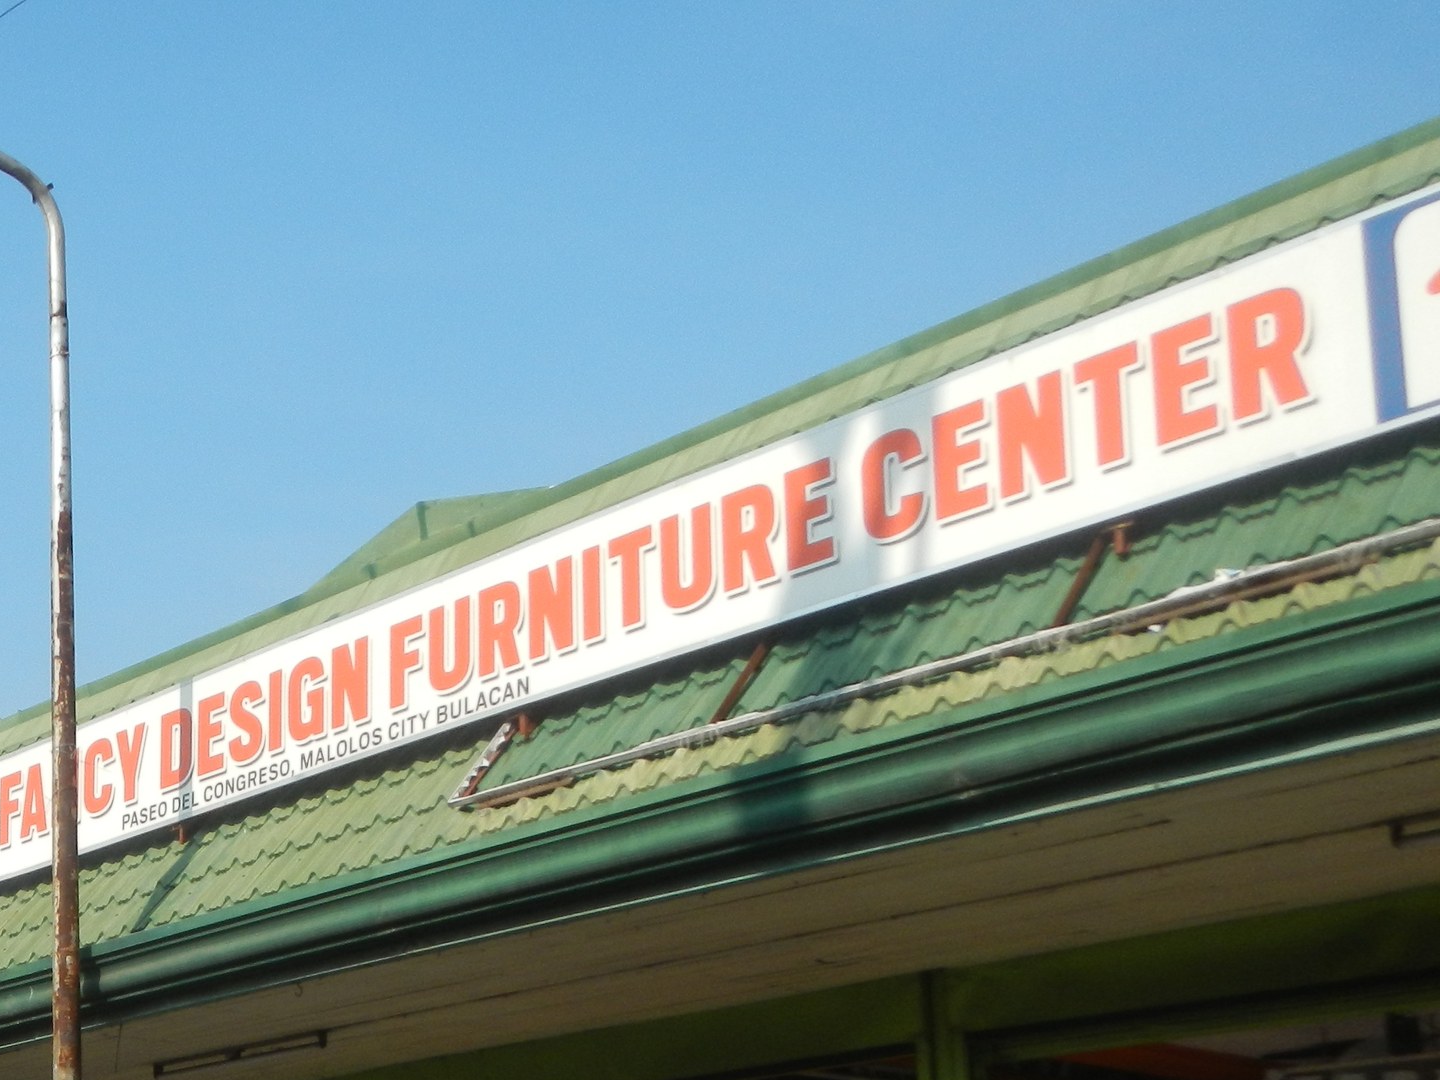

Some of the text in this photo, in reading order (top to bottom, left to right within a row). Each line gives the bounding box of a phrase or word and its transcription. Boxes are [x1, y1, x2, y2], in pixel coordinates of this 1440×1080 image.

[0, 722, 147, 849] FACY
[160, 635, 372, 790] DESIGN
[389, 456, 840, 711] FURNITURE
[861, 286, 1317, 544] CENTER
[122, 676, 531, 830] PASEO DEL CONGRESO, MALOLOS CITY BULACAN
